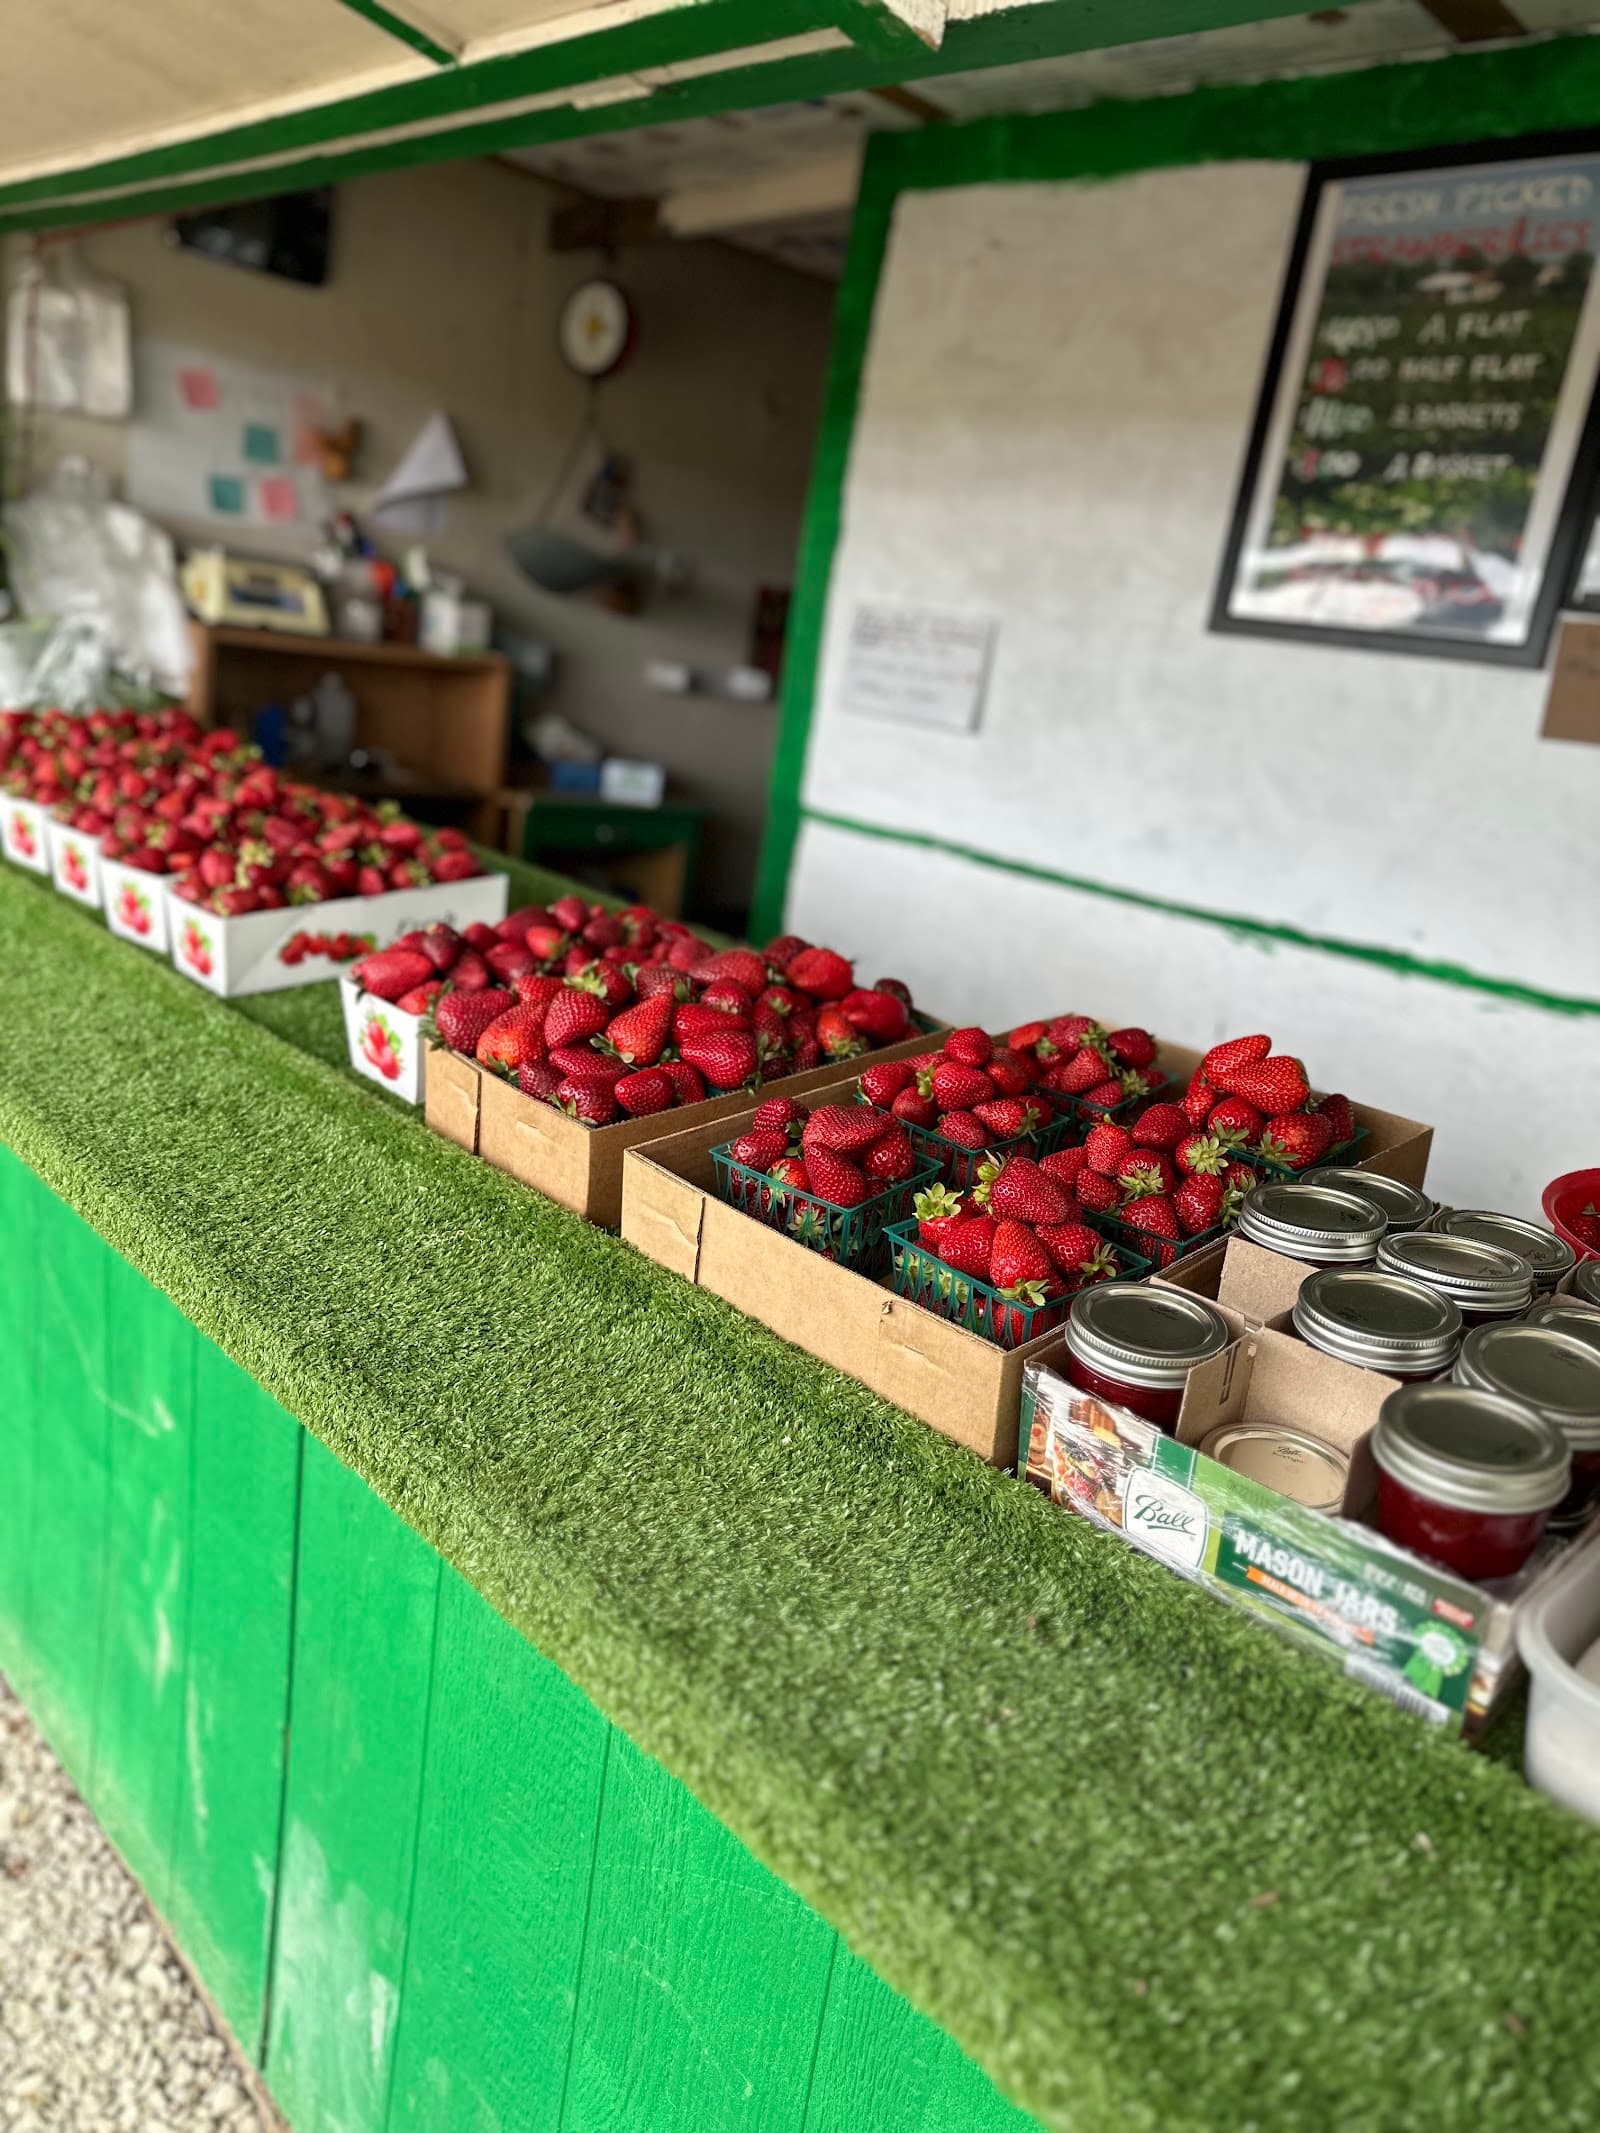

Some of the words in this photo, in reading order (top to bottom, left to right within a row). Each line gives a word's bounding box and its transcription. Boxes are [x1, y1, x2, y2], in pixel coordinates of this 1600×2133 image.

[1455, 309, 1532, 345] FLAT
[1469, 352, 1545, 383] FLAT
[1134, 1494, 1197, 1537] Ball
[1233, 1528, 1325, 1598] MASON
[1331, 1577, 1399, 1636] JARS
